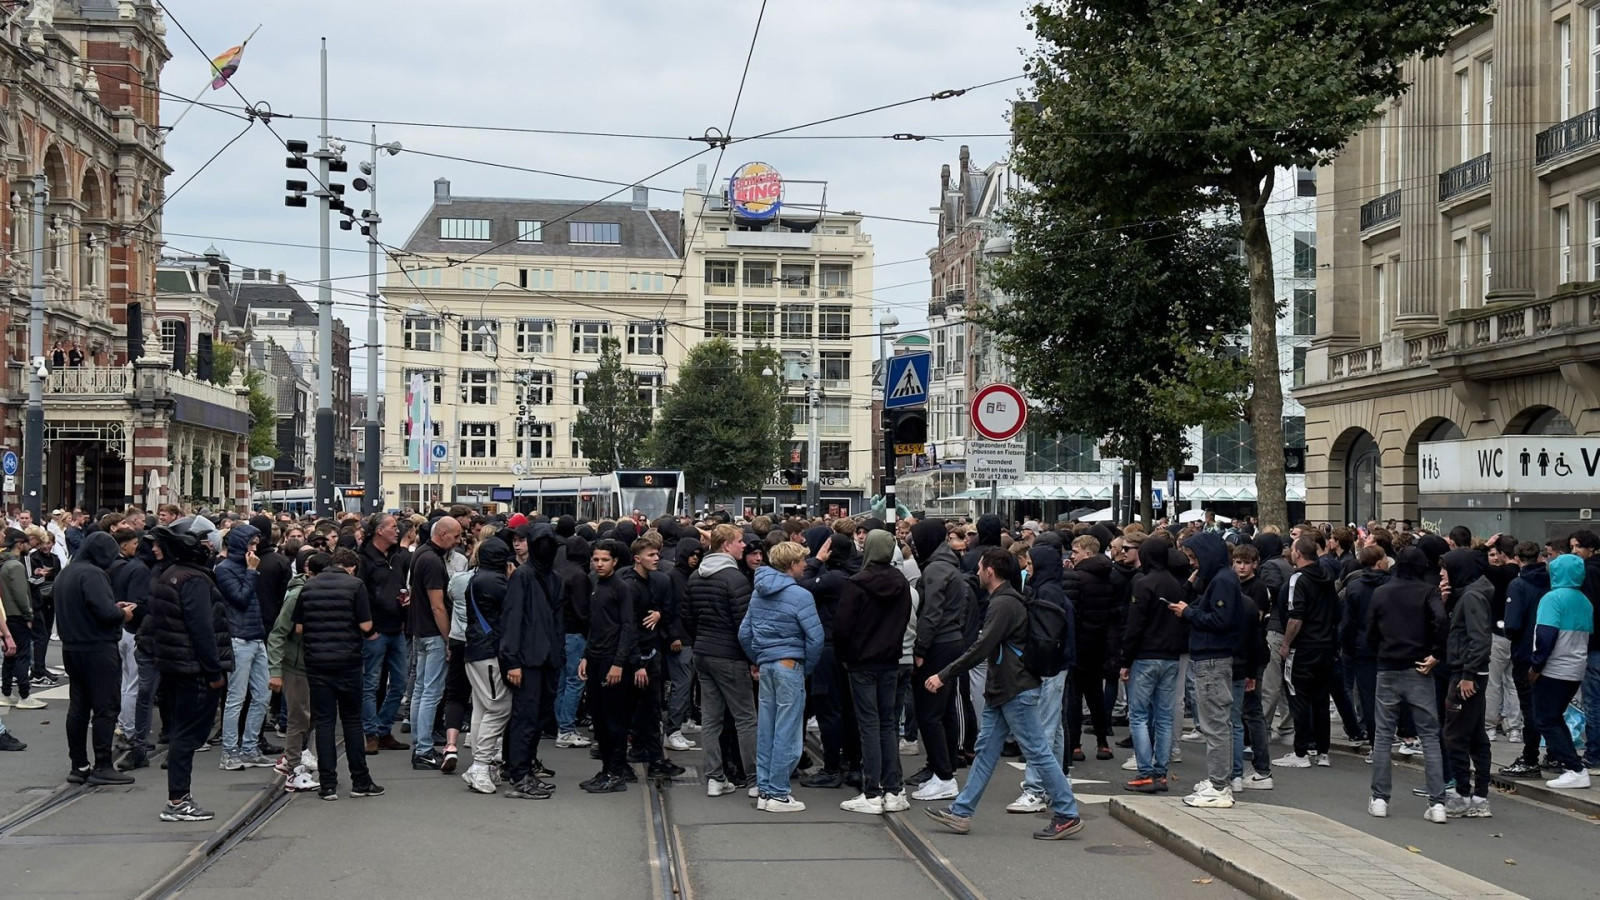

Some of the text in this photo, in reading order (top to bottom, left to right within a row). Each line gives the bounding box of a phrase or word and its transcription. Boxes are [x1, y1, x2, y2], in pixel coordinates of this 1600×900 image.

[735, 183, 780, 202] KING
[1478, 448, 1503, 478] WC
[644, 475, 653, 484] 12
